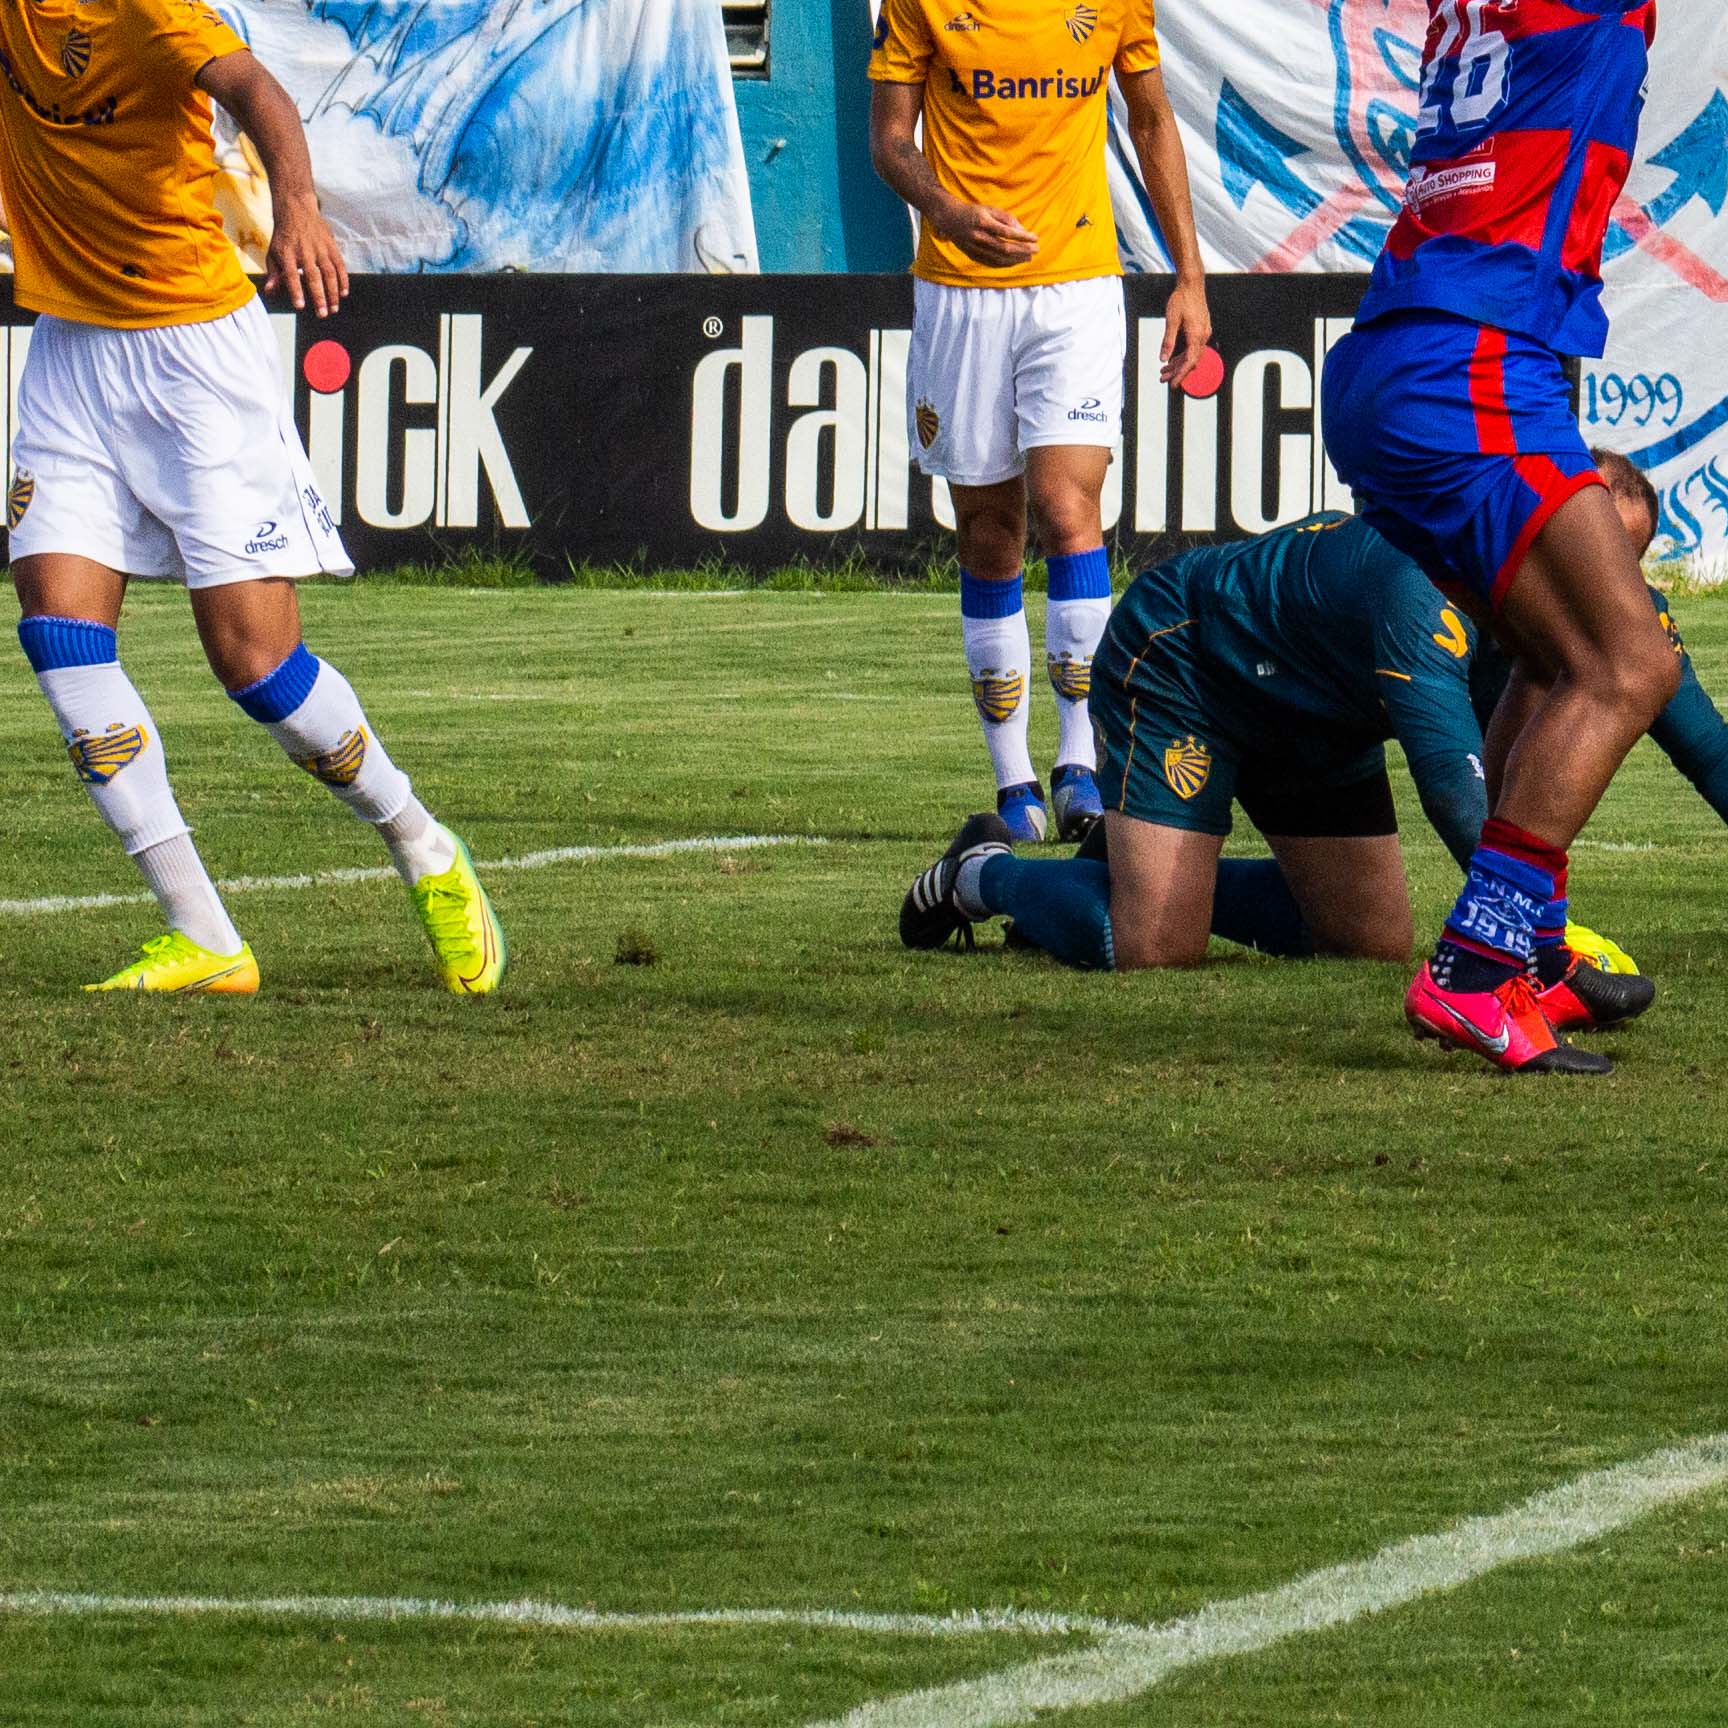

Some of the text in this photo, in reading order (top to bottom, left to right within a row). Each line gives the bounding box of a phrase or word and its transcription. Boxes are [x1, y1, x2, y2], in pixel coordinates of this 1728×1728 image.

[972, 66, 1105, 100] Banrisul
[1437, 167, 1492, 188] SHOPPING
[1583, 372, 1683, 427] 1999
[1067, 407, 1108, 423] dresch
[245, 533, 289, 554] dresch
